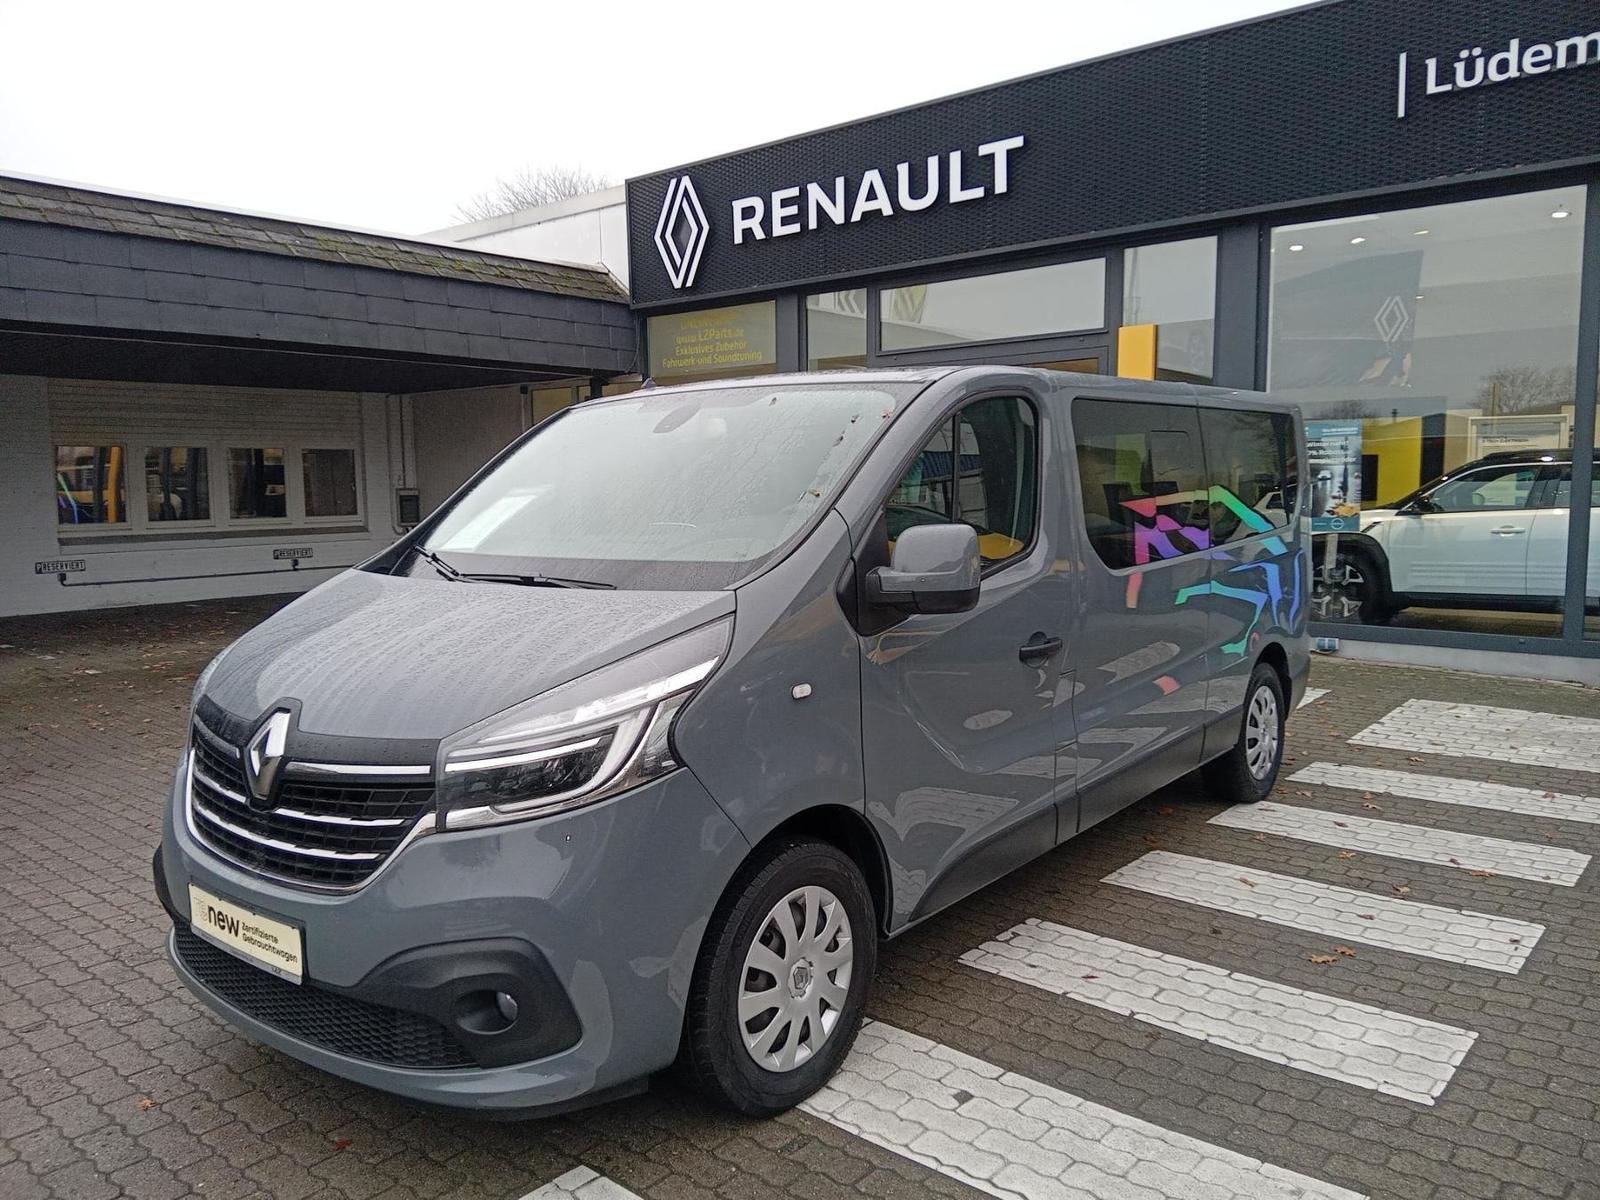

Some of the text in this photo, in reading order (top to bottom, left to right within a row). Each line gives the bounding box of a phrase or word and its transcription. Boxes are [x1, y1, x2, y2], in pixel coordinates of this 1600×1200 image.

[1425, 31, 1600, 95] Lüdem
[731, 135, 1025, 245] RENAULT
[42, 560, 85, 572] RESERVIERT
[242, 933, 298, 963] Gebrauchtwagen
